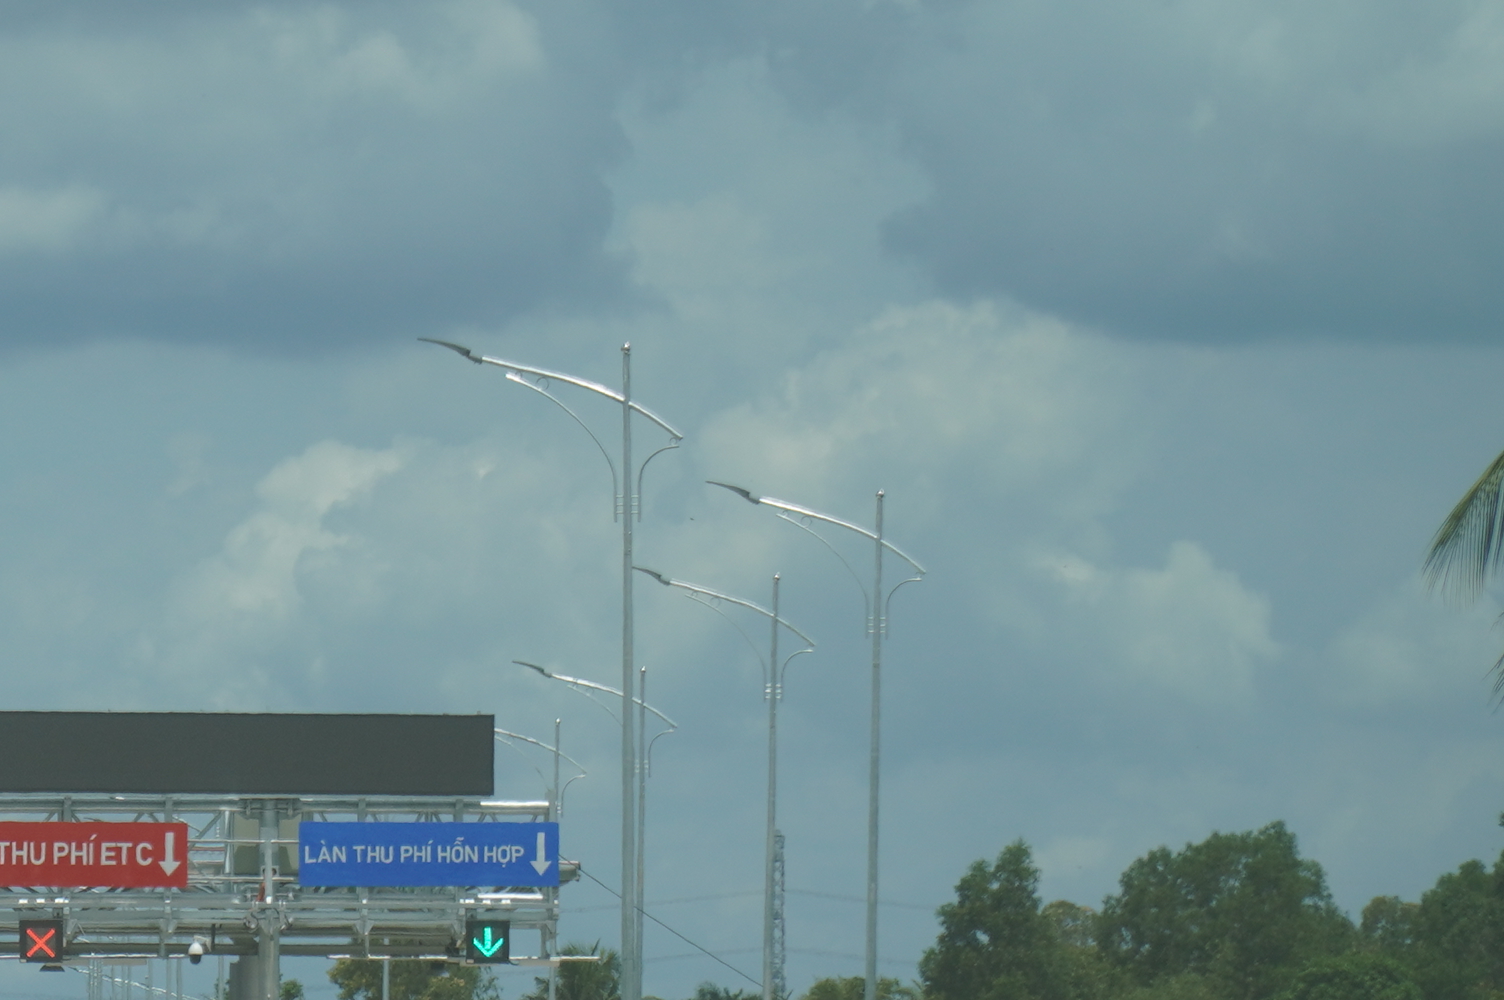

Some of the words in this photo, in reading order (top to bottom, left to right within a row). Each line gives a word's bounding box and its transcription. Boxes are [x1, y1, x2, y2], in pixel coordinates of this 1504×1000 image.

[53, 834, 97, 865] PHÍ
[100, 842, 153, 866] ETC
[304, 840, 346, 864] LÀN
[353, 845, 394, 864] THU
[400, 840, 434, 863] PHÍ
[437, 836, 479, 864] HỖN
[484, 844, 525, 868] HỢP
